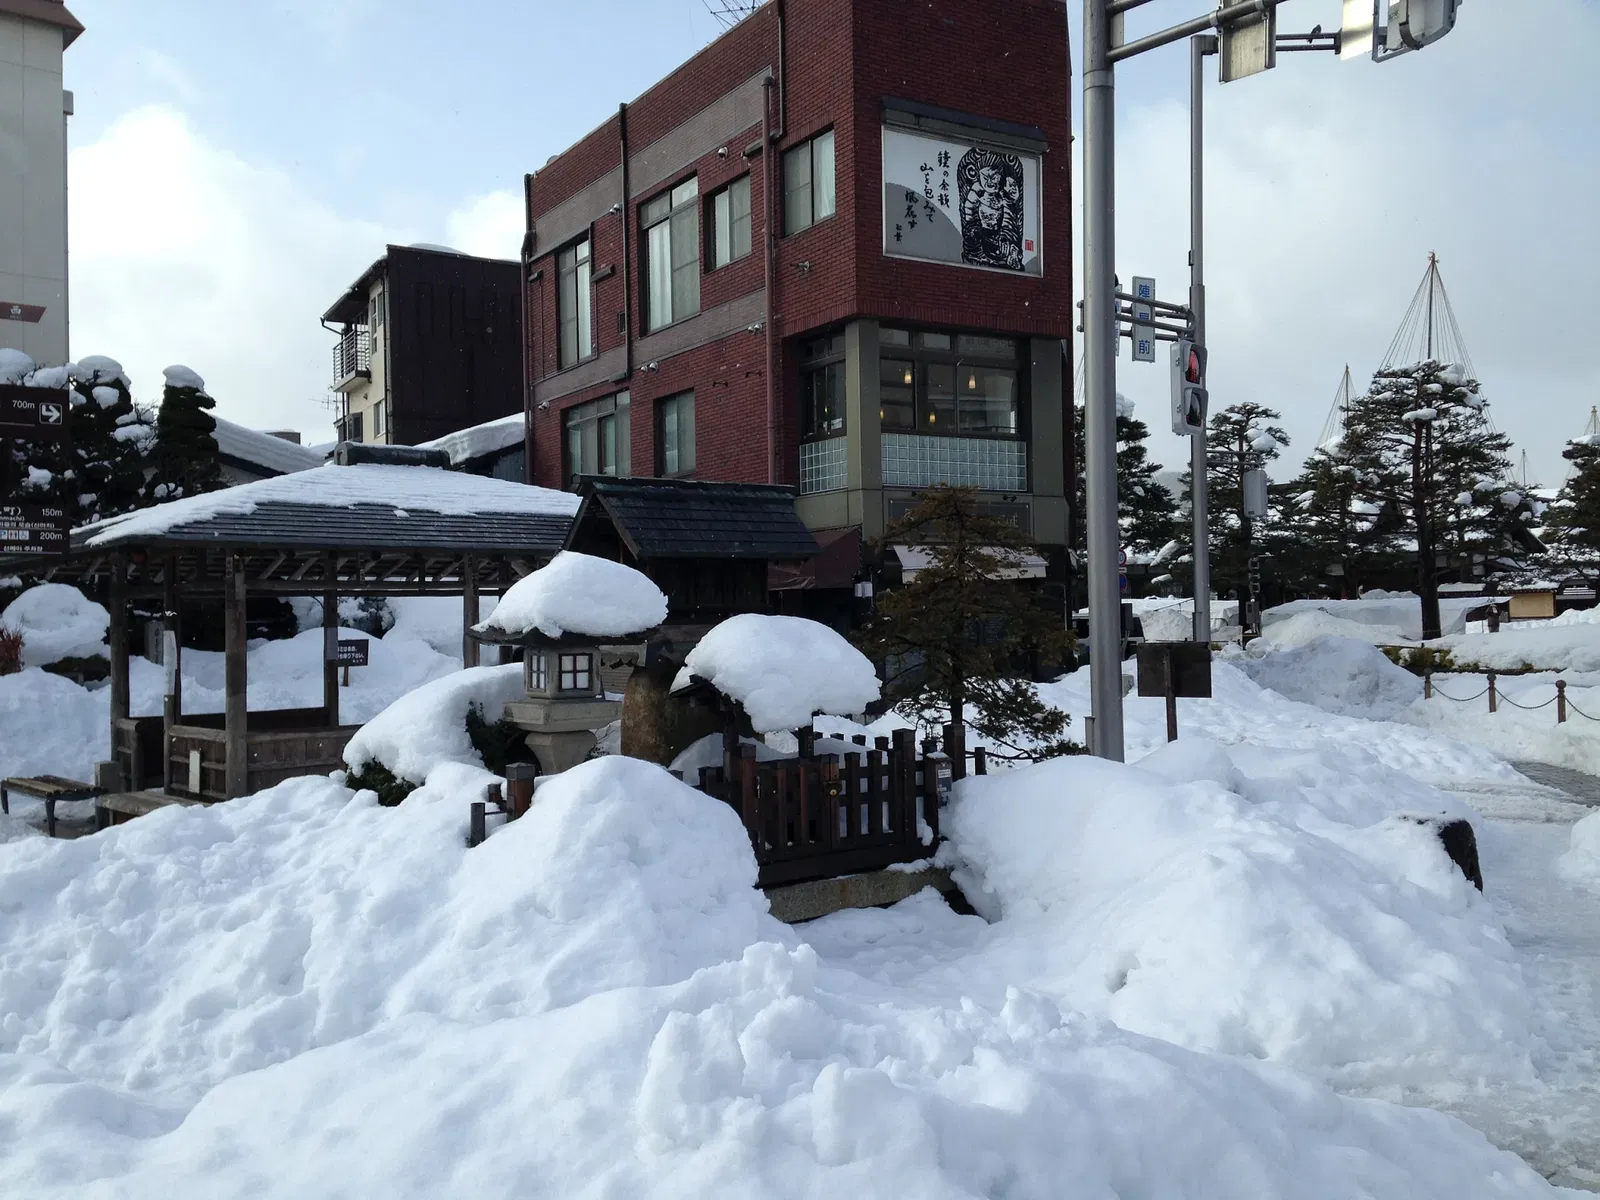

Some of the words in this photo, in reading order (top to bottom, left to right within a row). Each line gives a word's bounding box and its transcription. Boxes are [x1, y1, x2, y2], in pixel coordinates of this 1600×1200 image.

[12, 399, 35, 409] 700m
[41, 508, 63, 517] 150m
[39, 531, 63, 541] 200m
